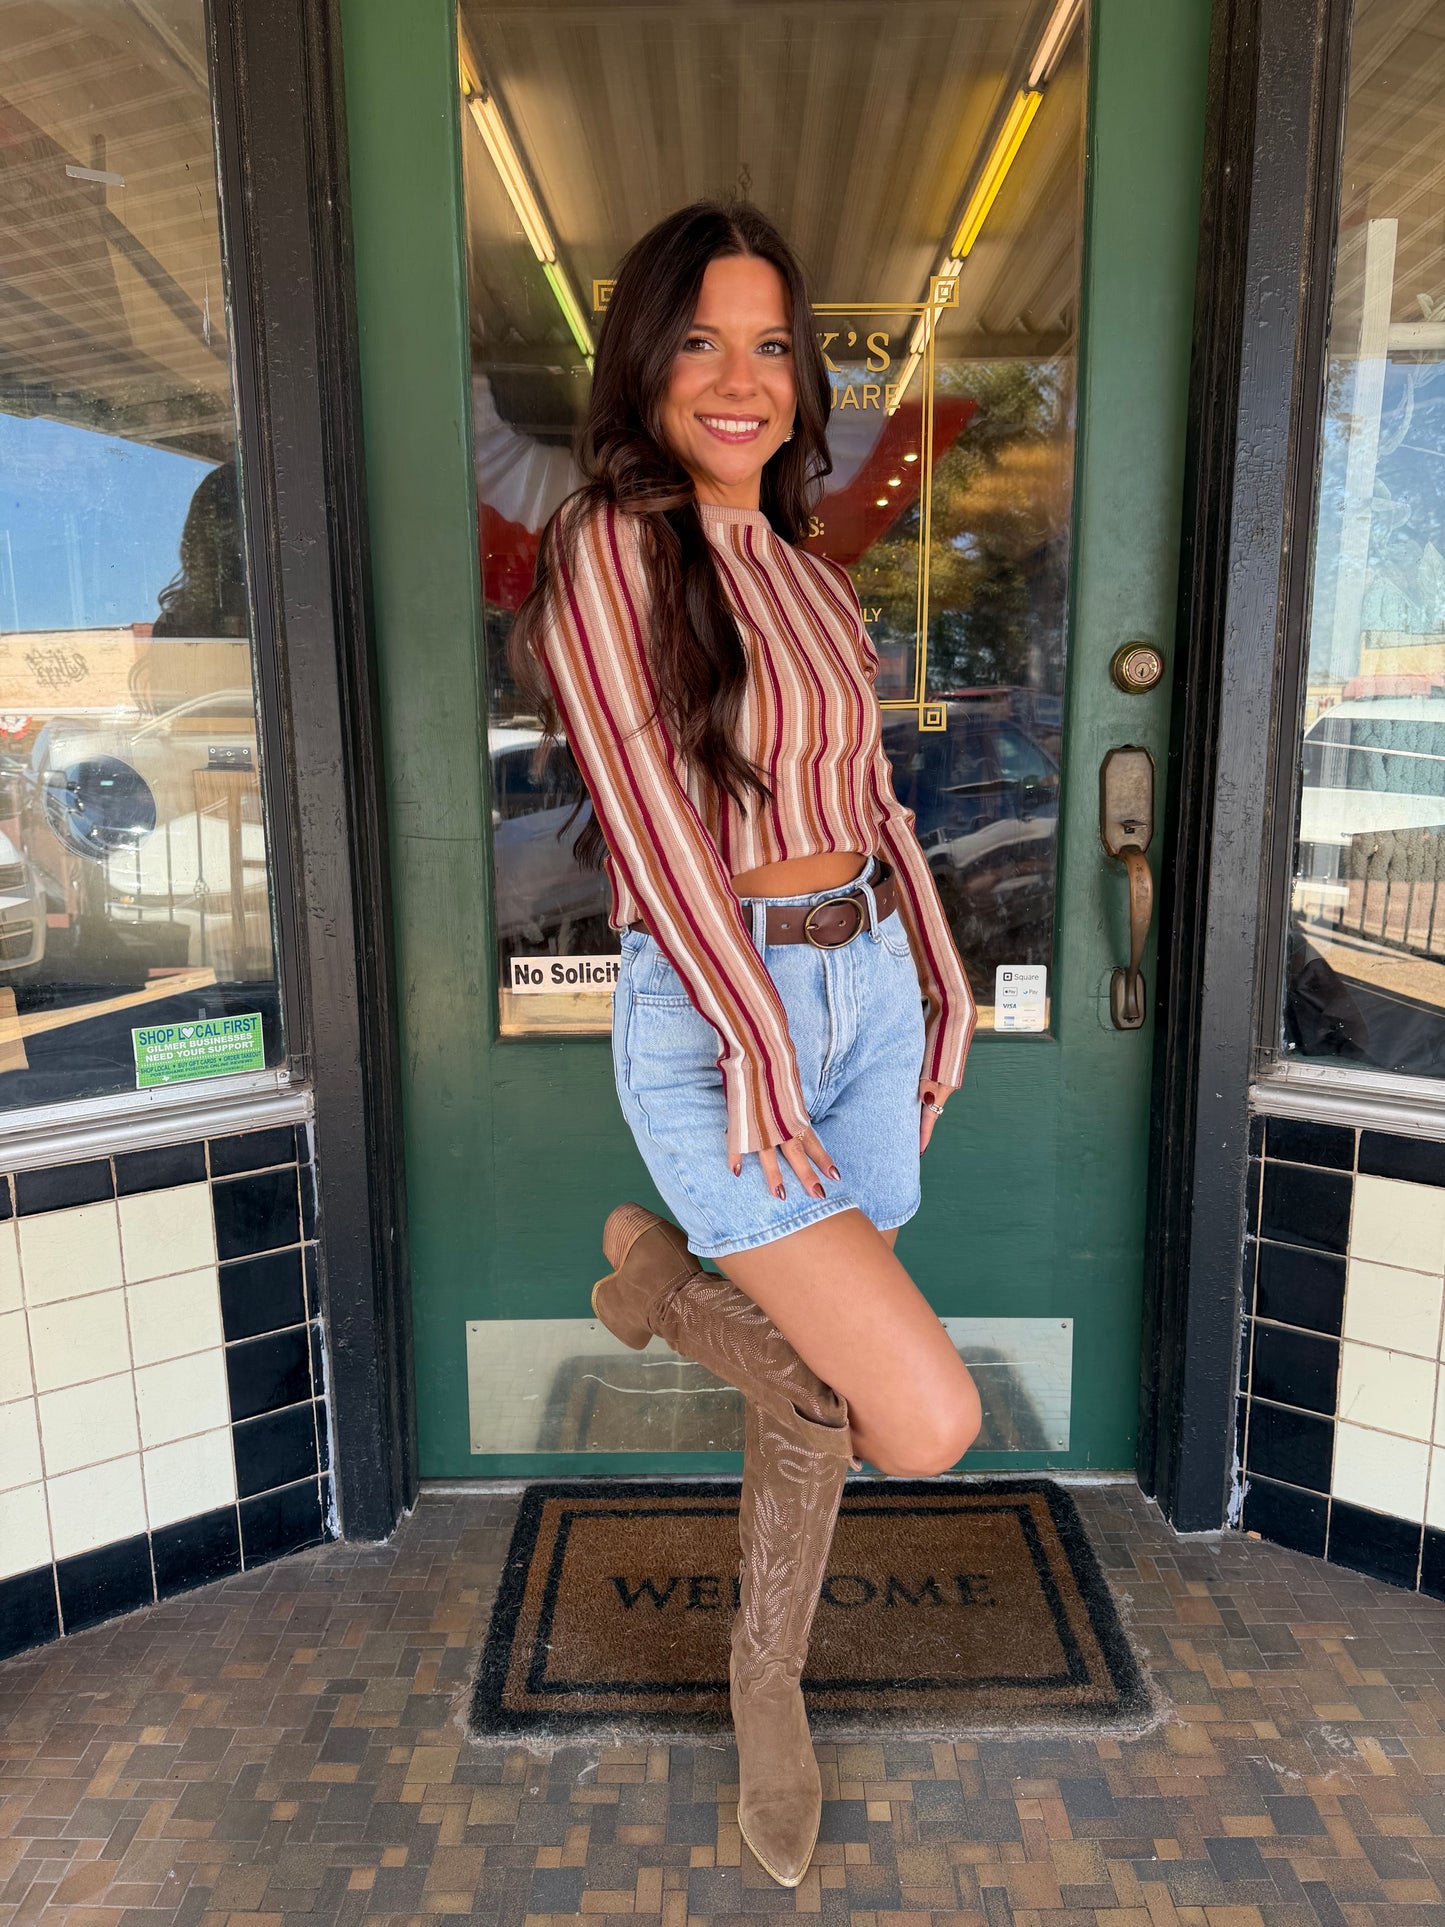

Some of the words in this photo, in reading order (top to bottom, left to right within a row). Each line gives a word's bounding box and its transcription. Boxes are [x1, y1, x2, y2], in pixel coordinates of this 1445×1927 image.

[514, 964, 544, 985] No
[1014, 973, 1039, 981] Square
[138, 1028, 174, 1046] SHOP
[223, 1017, 257, 1035] FIRST
[145, 1052, 174, 1063] NEED
[176, 1047, 205, 1058] YOUR
[207, 1040, 255, 1054] SUPPORT
[146, 1041, 186, 1054] GILMER
[189, 1032, 253, 1048] BUSINESSES
[611, 1574, 997, 1608] WEOME
